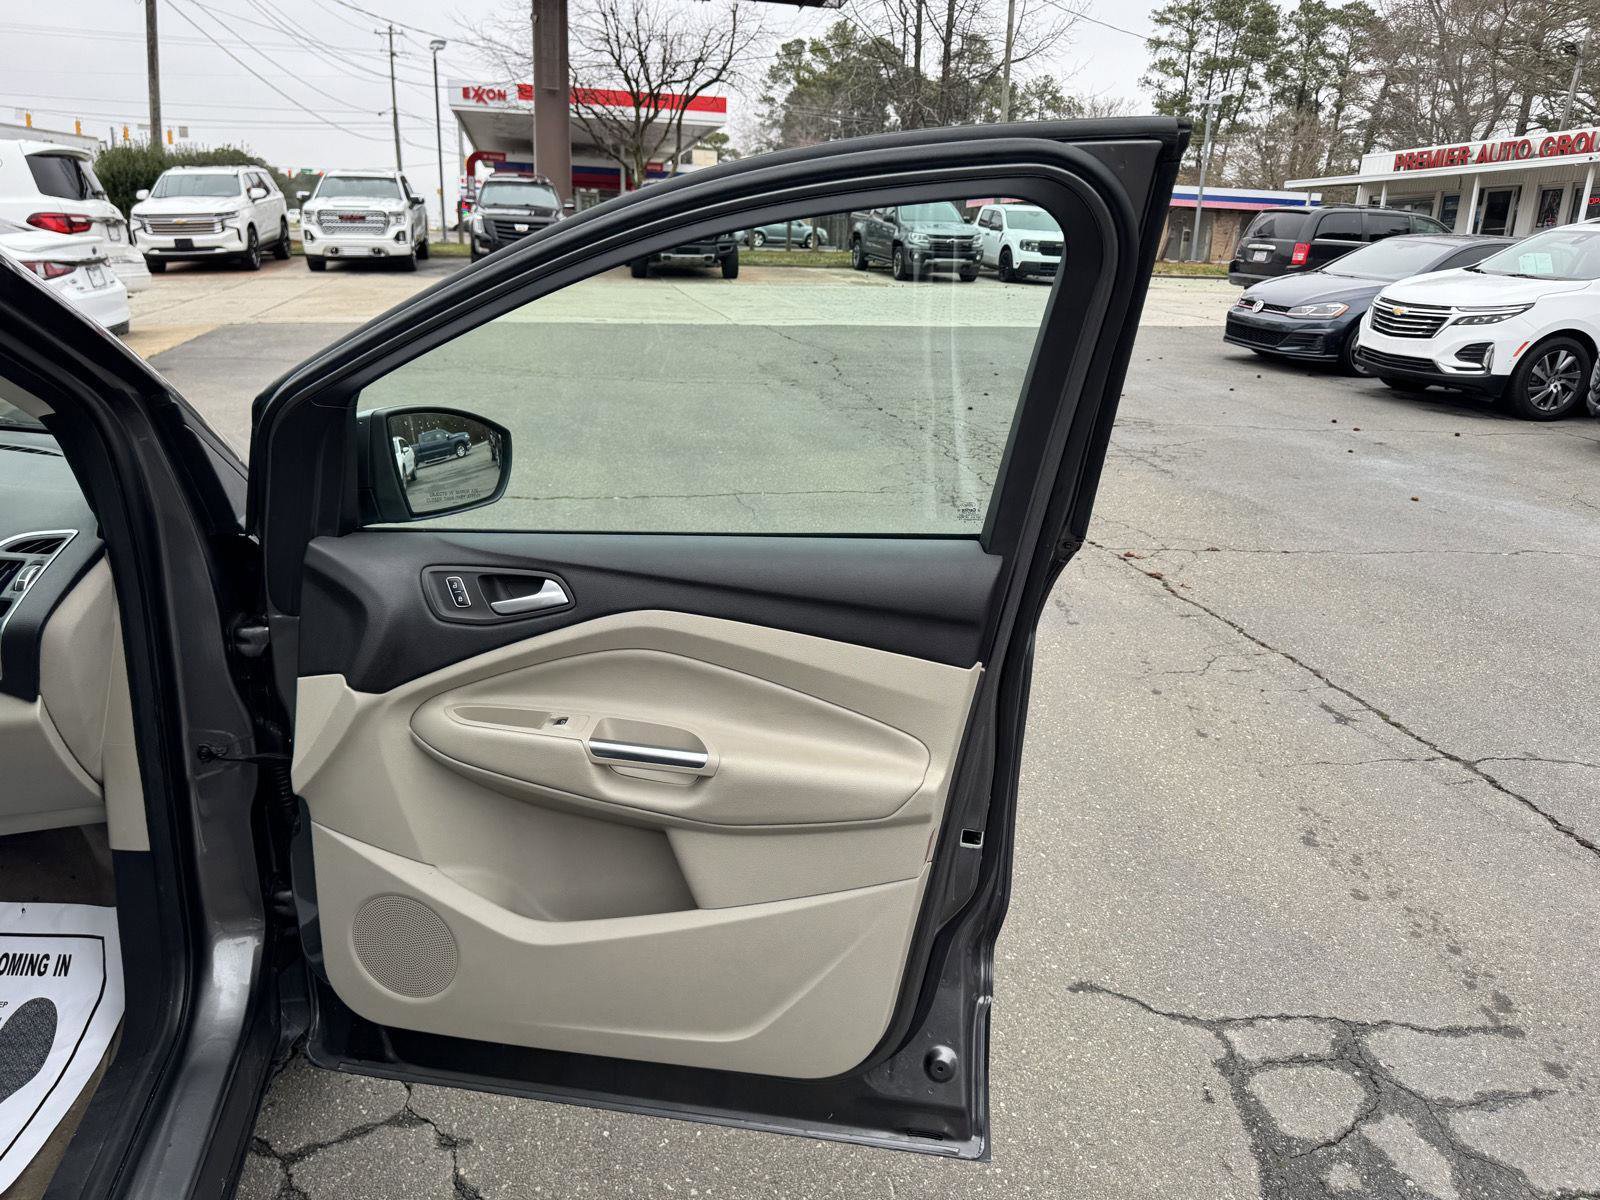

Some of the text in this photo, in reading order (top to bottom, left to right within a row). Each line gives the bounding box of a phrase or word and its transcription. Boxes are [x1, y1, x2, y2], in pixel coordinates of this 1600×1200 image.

[462, 85, 507, 105] EXXON
[1393, 145, 1473, 171] PREMIER
[1475, 138, 1532, 164] AUTO
[53, 954, 72, 977] IN
